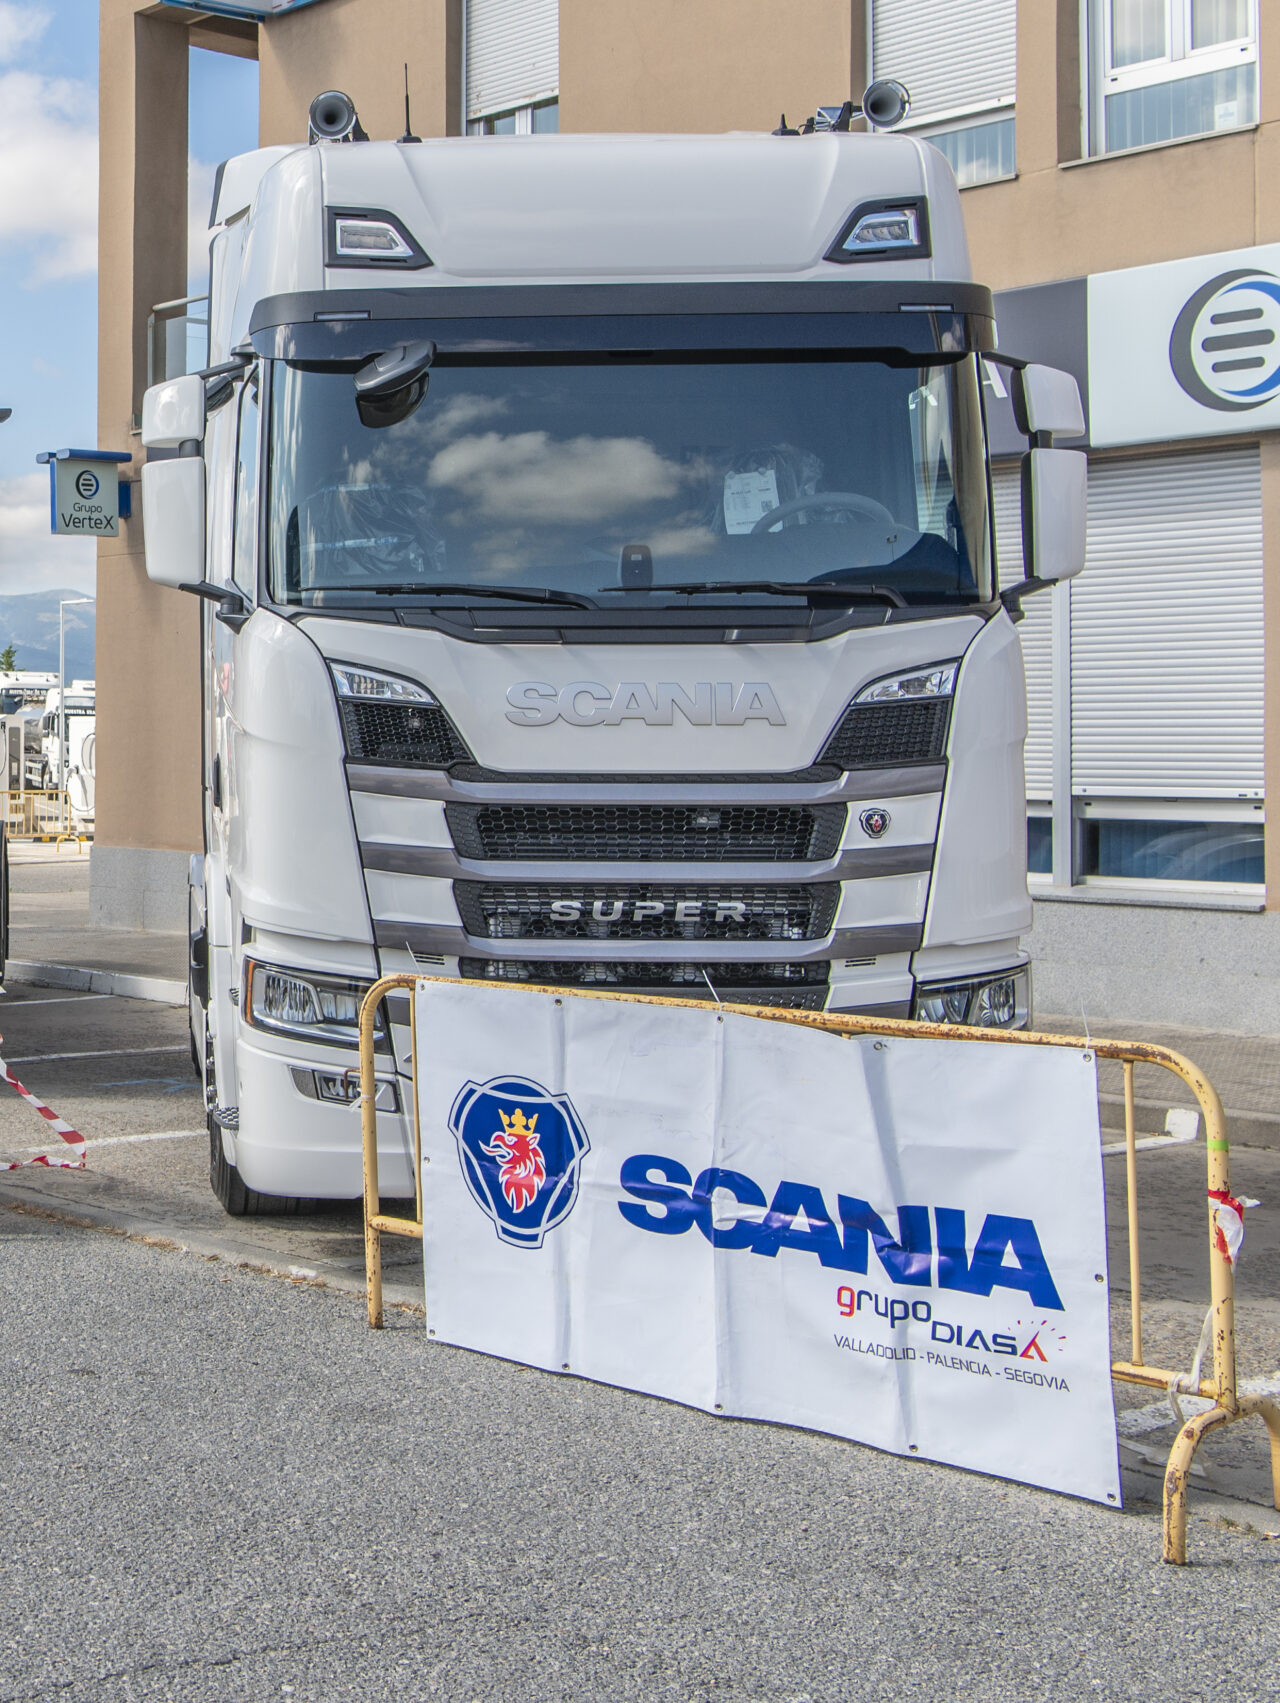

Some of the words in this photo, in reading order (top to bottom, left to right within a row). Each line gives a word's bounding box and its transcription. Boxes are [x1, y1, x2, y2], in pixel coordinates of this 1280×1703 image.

[61, 513, 115, 530] VerteX
[73, 502, 103, 514] Grupo
[505, 681, 787, 727] SCANIA
[550, 901, 746, 922] SUPER
[617, 1153, 1066, 1312] SCANIA
[836, 1285, 932, 1328] grupo
[834, 1334, 916, 1361] VALLADOLID
[927, 1351, 992, 1377] PALENCIA
[1004, 1366, 1071, 1392] SEGOVIA
